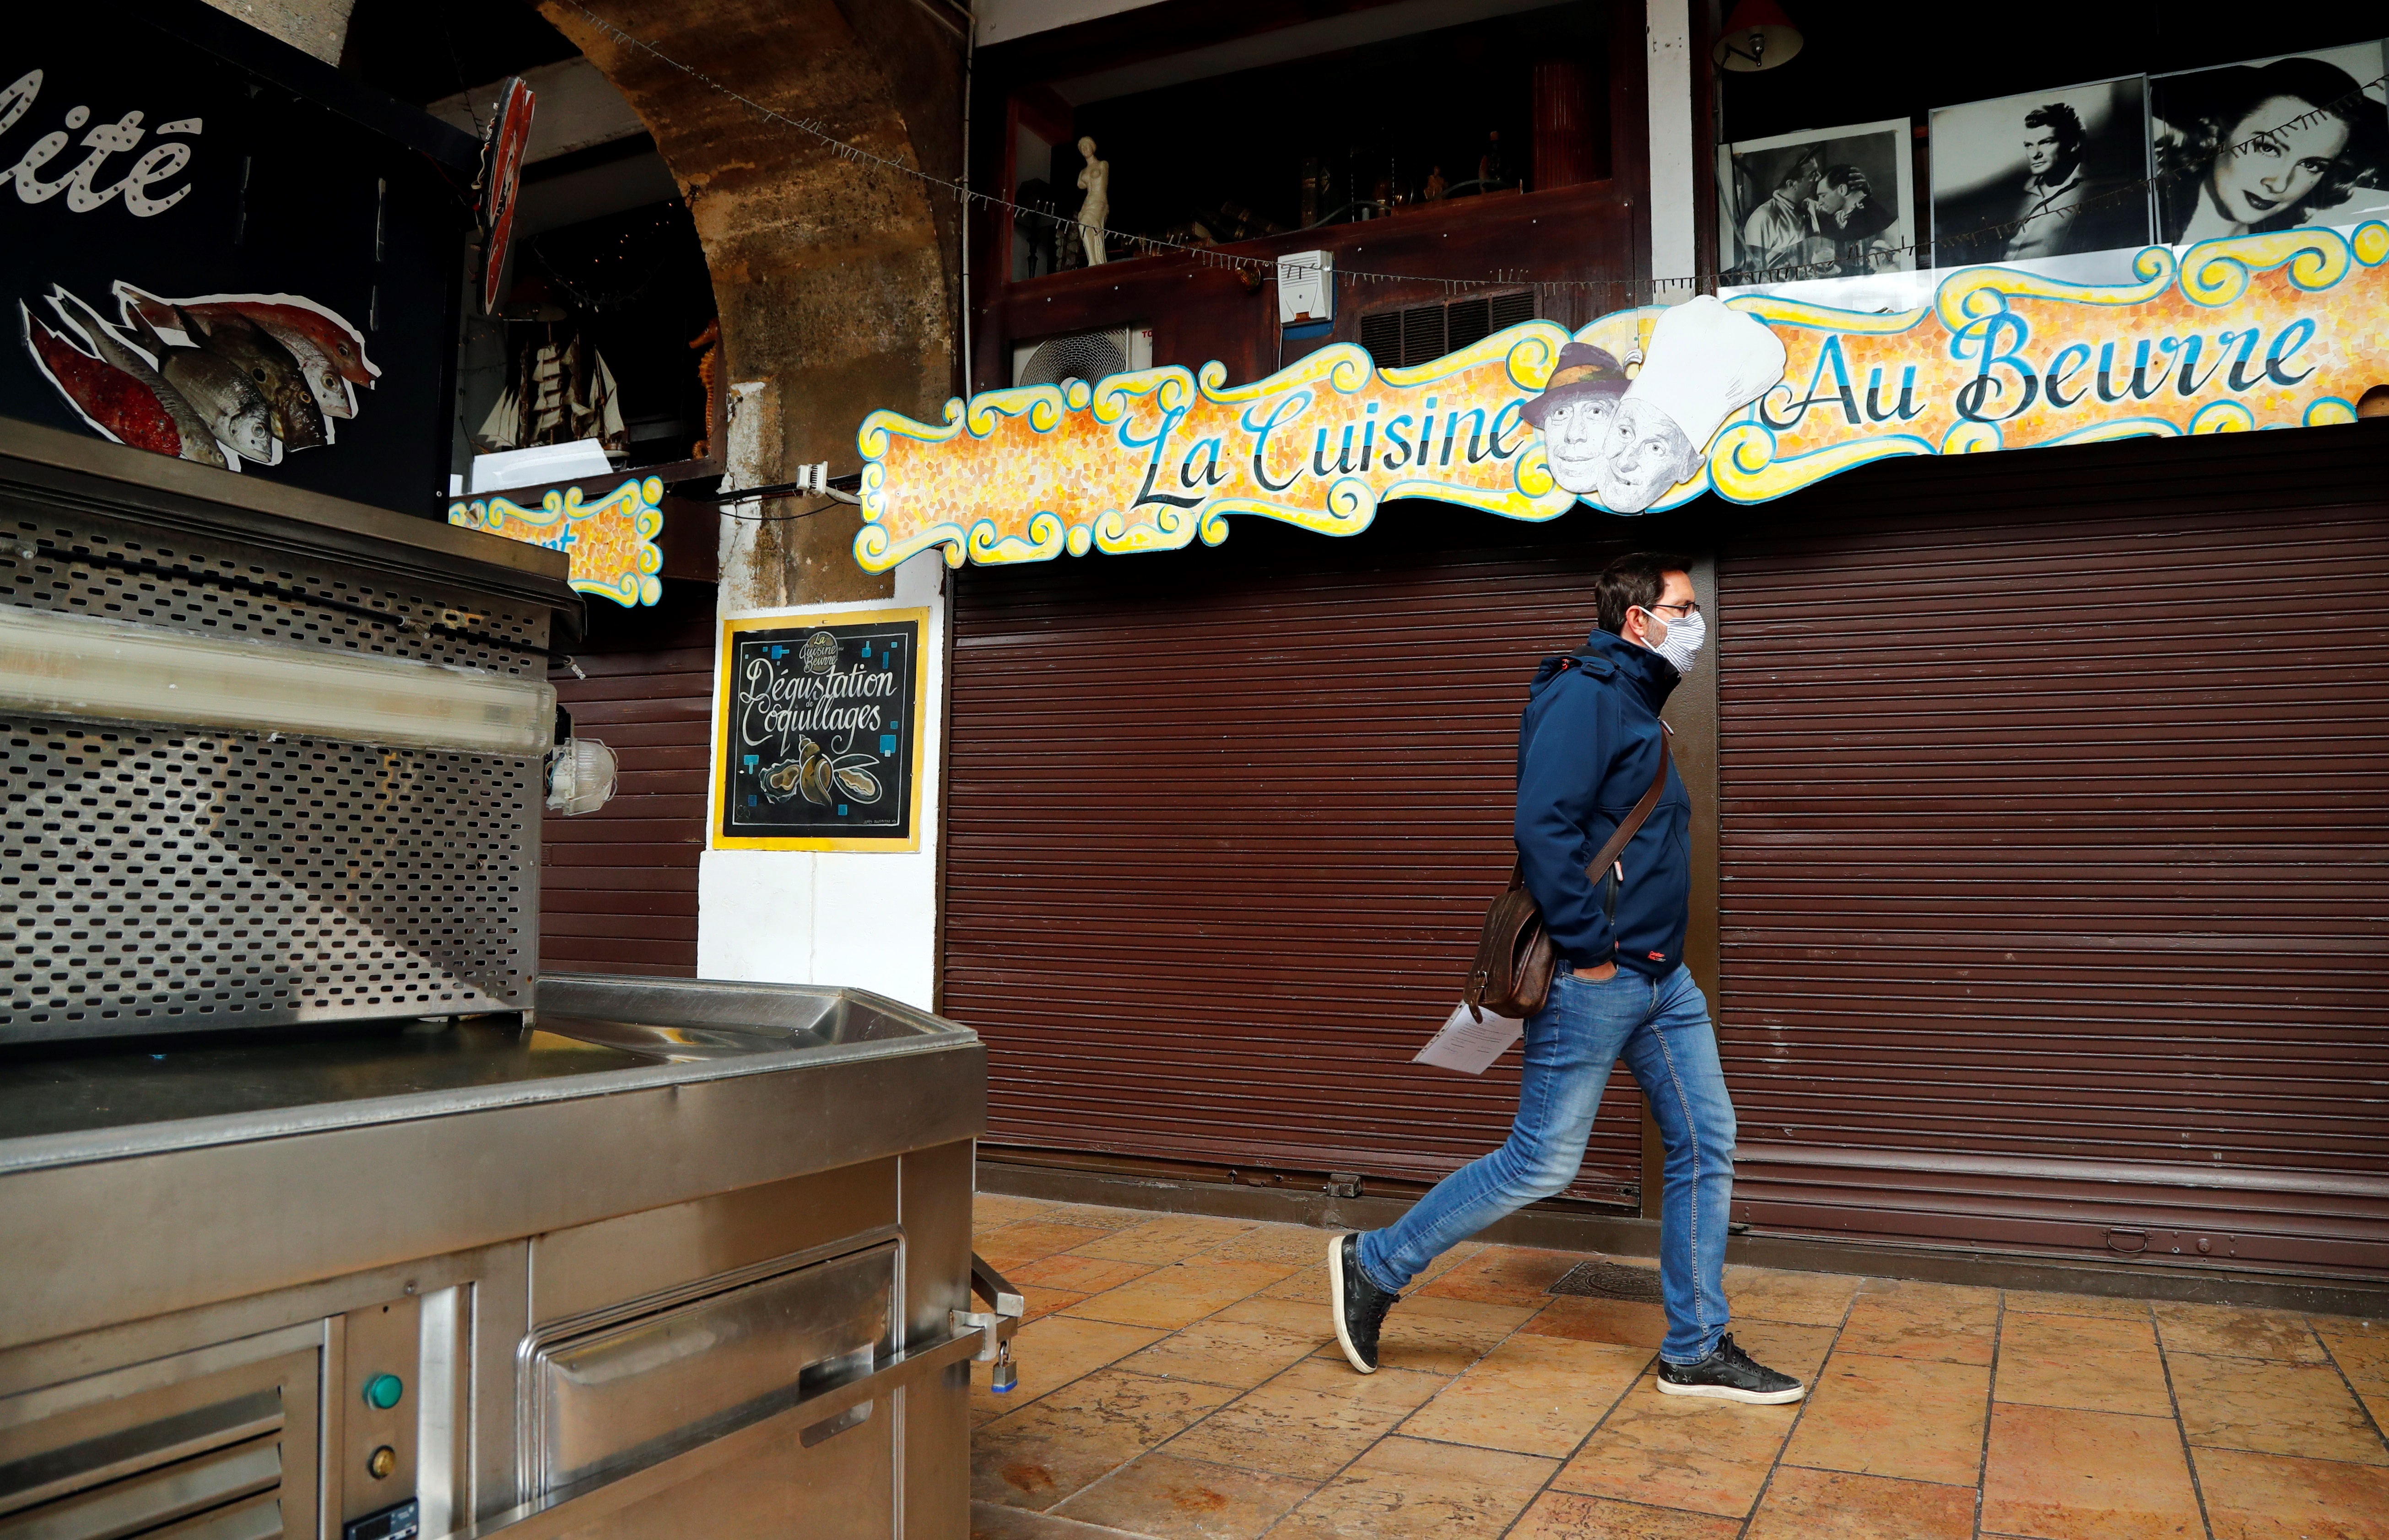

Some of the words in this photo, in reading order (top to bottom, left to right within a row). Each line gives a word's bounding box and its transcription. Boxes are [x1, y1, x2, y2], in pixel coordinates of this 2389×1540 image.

[1119, 406, 1228, 511] La
[1241, 390, 1526, 491] Cuisine
[1760, 334, 1926, 431] Au
[1950, 312, 2317, 423] Beurre
[813, 633, 827, 645] La
[799, 643, 837, 659] Cuisine
[804, 655, 838, 673] Beurre
[740, 658, 898, 717] Dégustation
[805, 697, 814, 707] de
[742, 693, 881, 757] Coquillages
